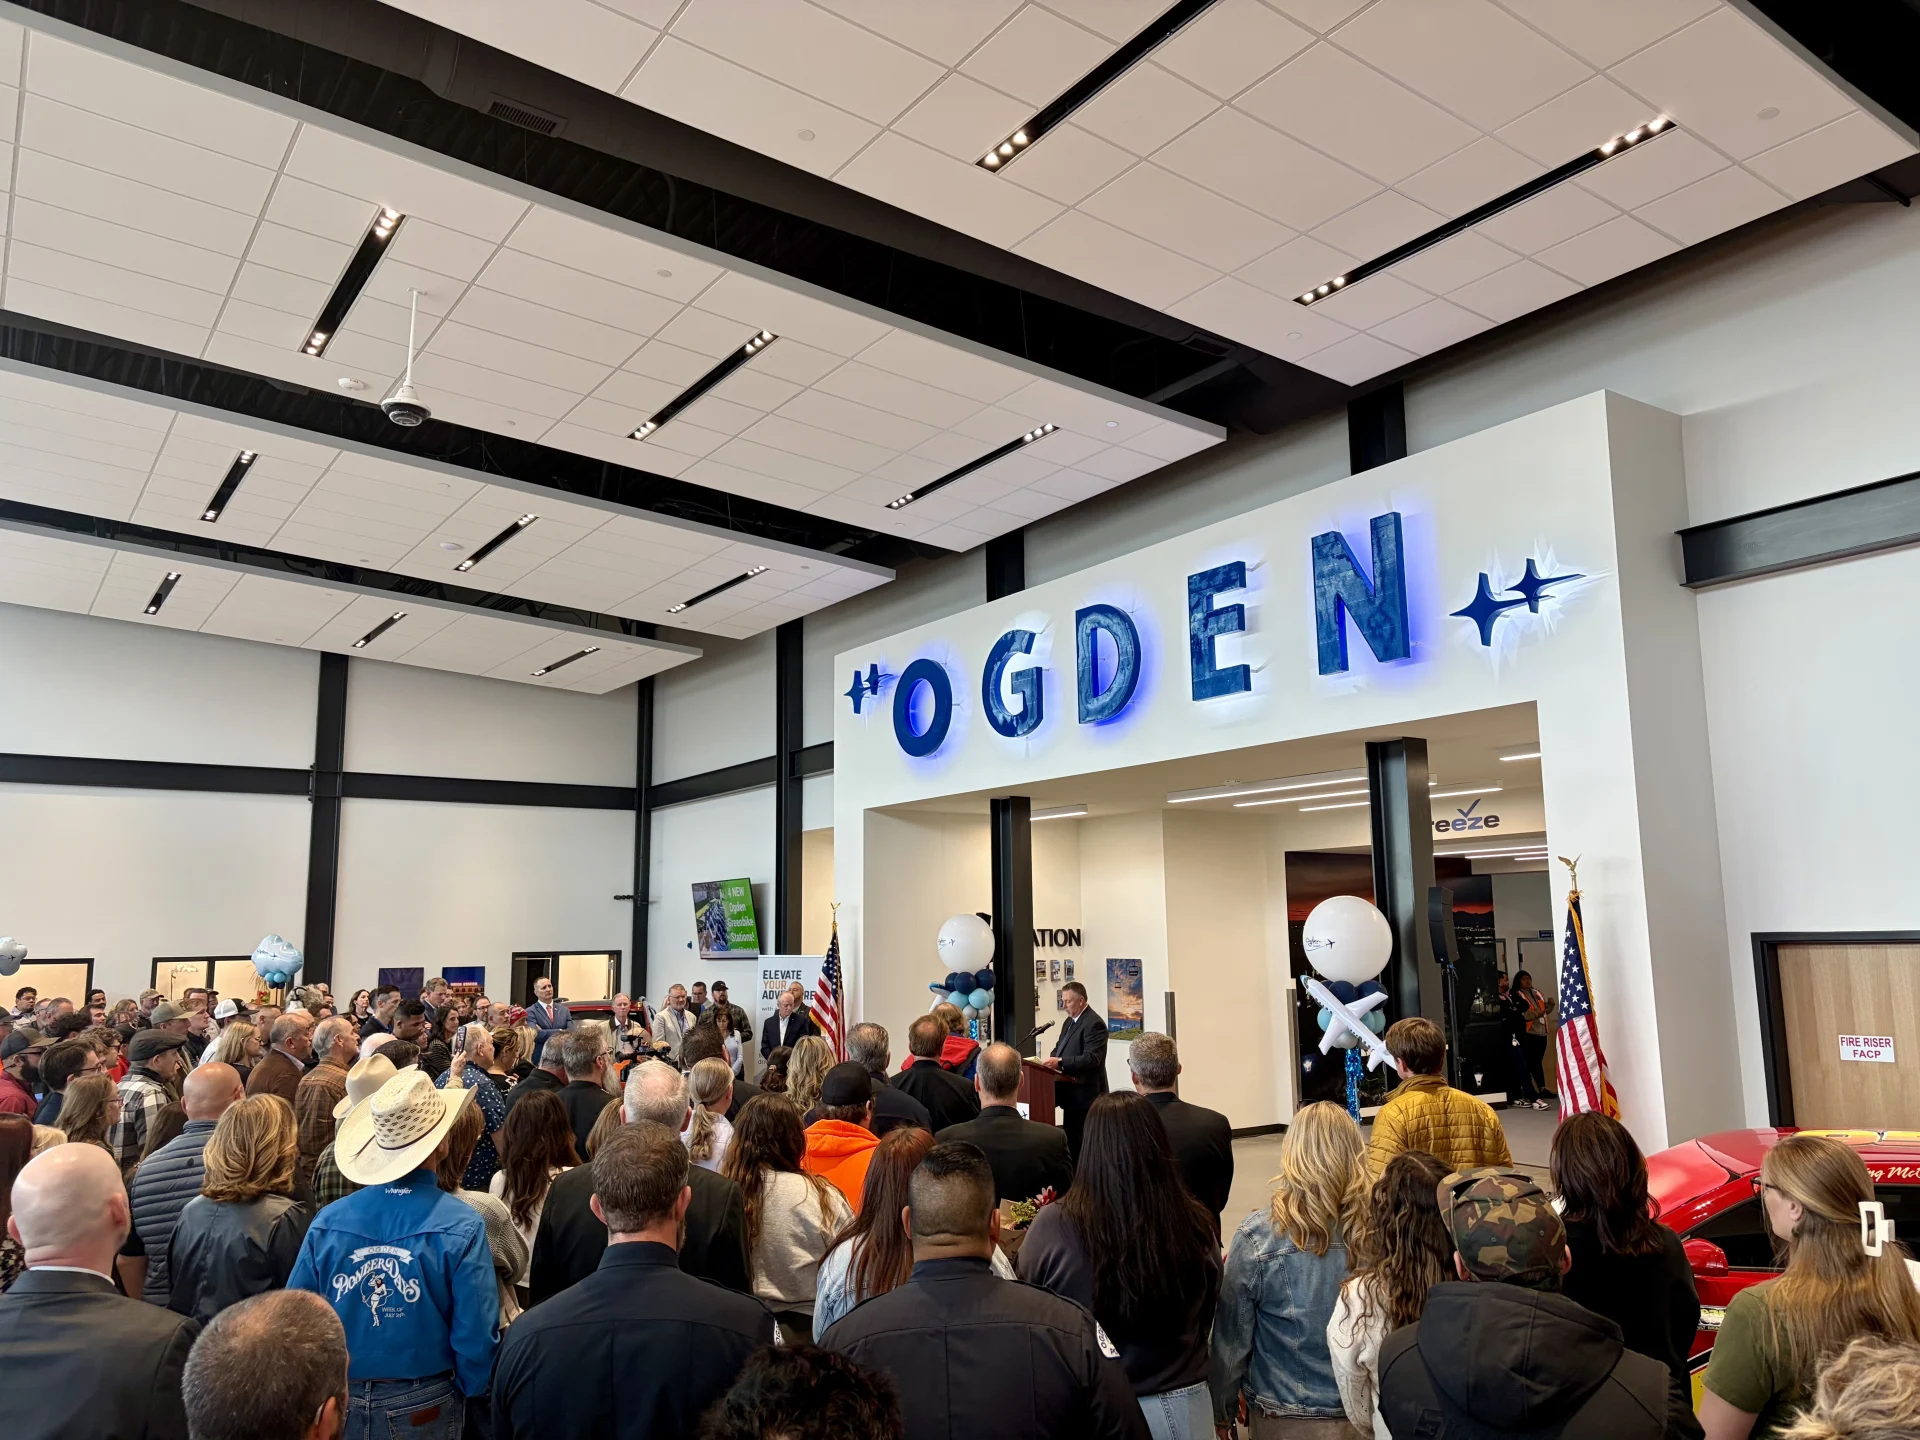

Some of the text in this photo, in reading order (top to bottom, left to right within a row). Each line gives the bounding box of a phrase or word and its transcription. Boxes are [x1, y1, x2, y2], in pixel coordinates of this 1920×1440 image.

[892, 511, 1412, 759] OGDEN
[1432, 815, 1500, 833] eeze
[732, 886, 745, 897] NEW
[729, 901, 747, 914] Ogden
[727, 916, 754, 928] Greenbike
[731, 931, 755, 942] Stations!
[763, 970, 802, 980] ELEVATE
[763, 980, 787, 990] YOUR
[1840, 1036, 1892, 1048] FIRE RISER
[1853, 1049, 1881, 1059] FACP
[385, 1187, 412, 1196] Wrangler
[368, 1246, 399, 1254] OGDEN
